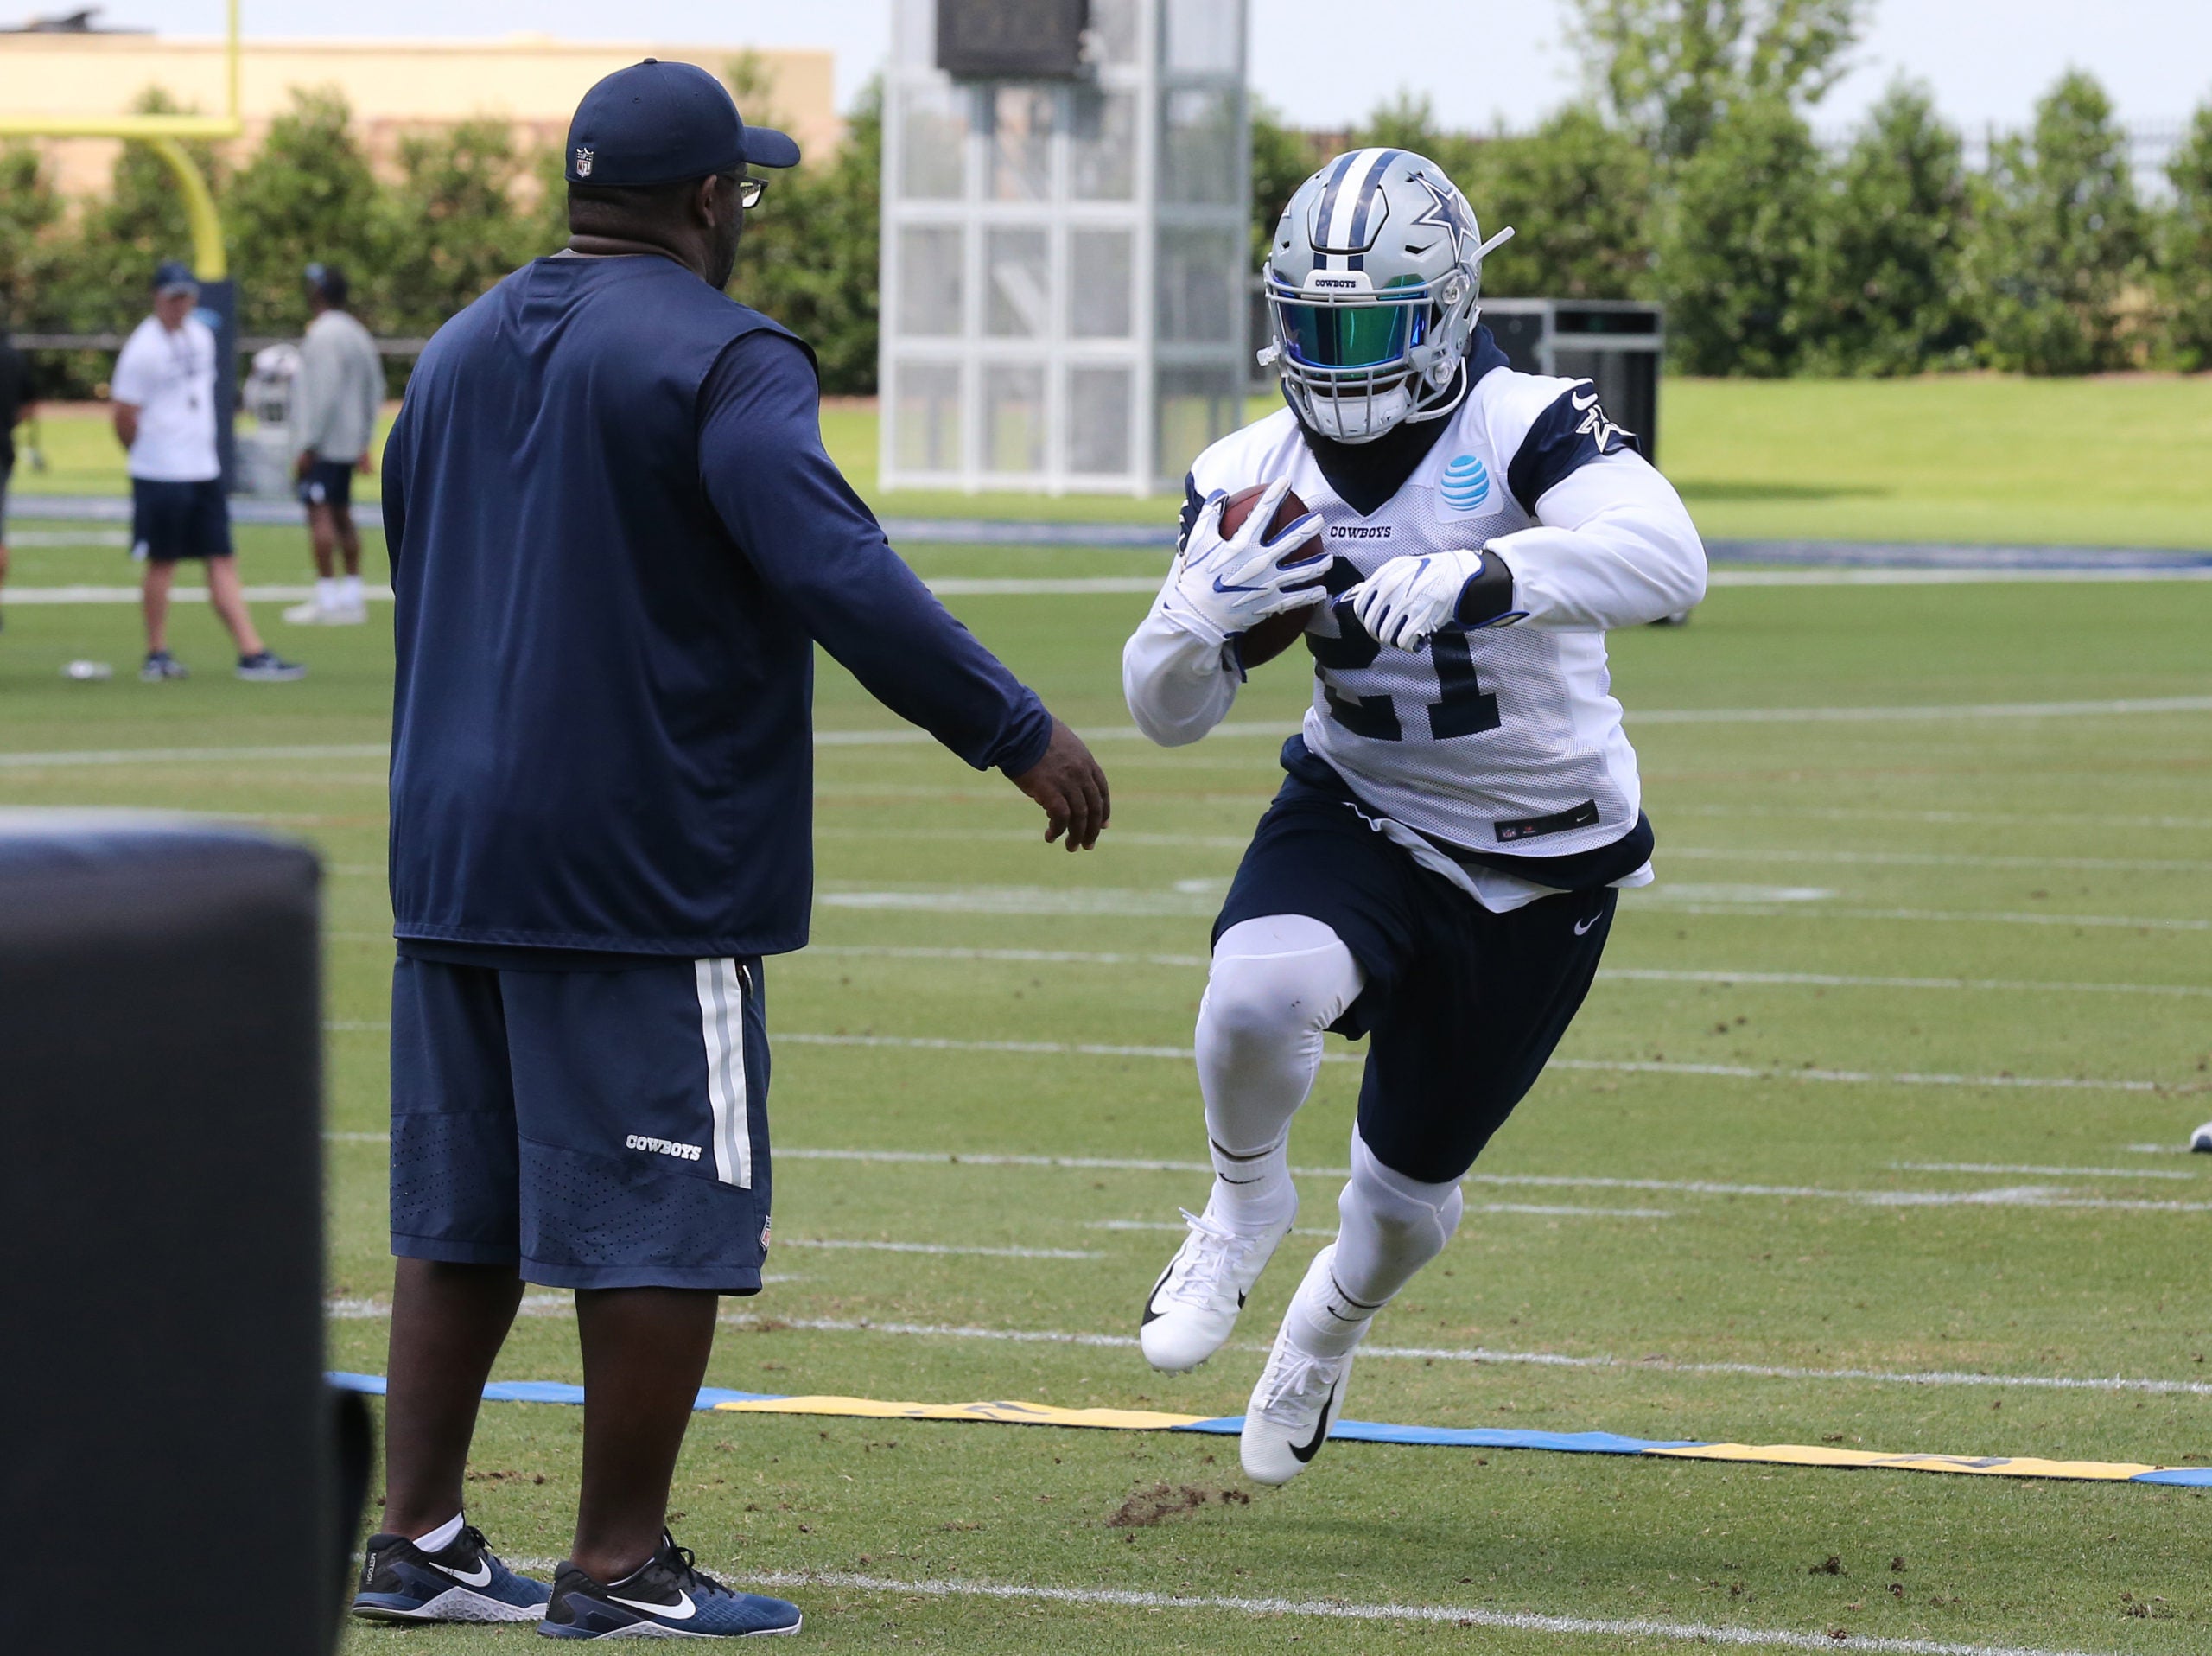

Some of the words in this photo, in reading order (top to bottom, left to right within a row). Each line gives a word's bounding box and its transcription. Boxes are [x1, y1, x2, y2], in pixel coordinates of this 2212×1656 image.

[1315, 279, 1356, 288] COWBOYS
[1331, 526, 1391, 538] COWBOYS
[1304, 556, 1501, 741] 21
[626, 1134, 702, 1161] COWBOYS
